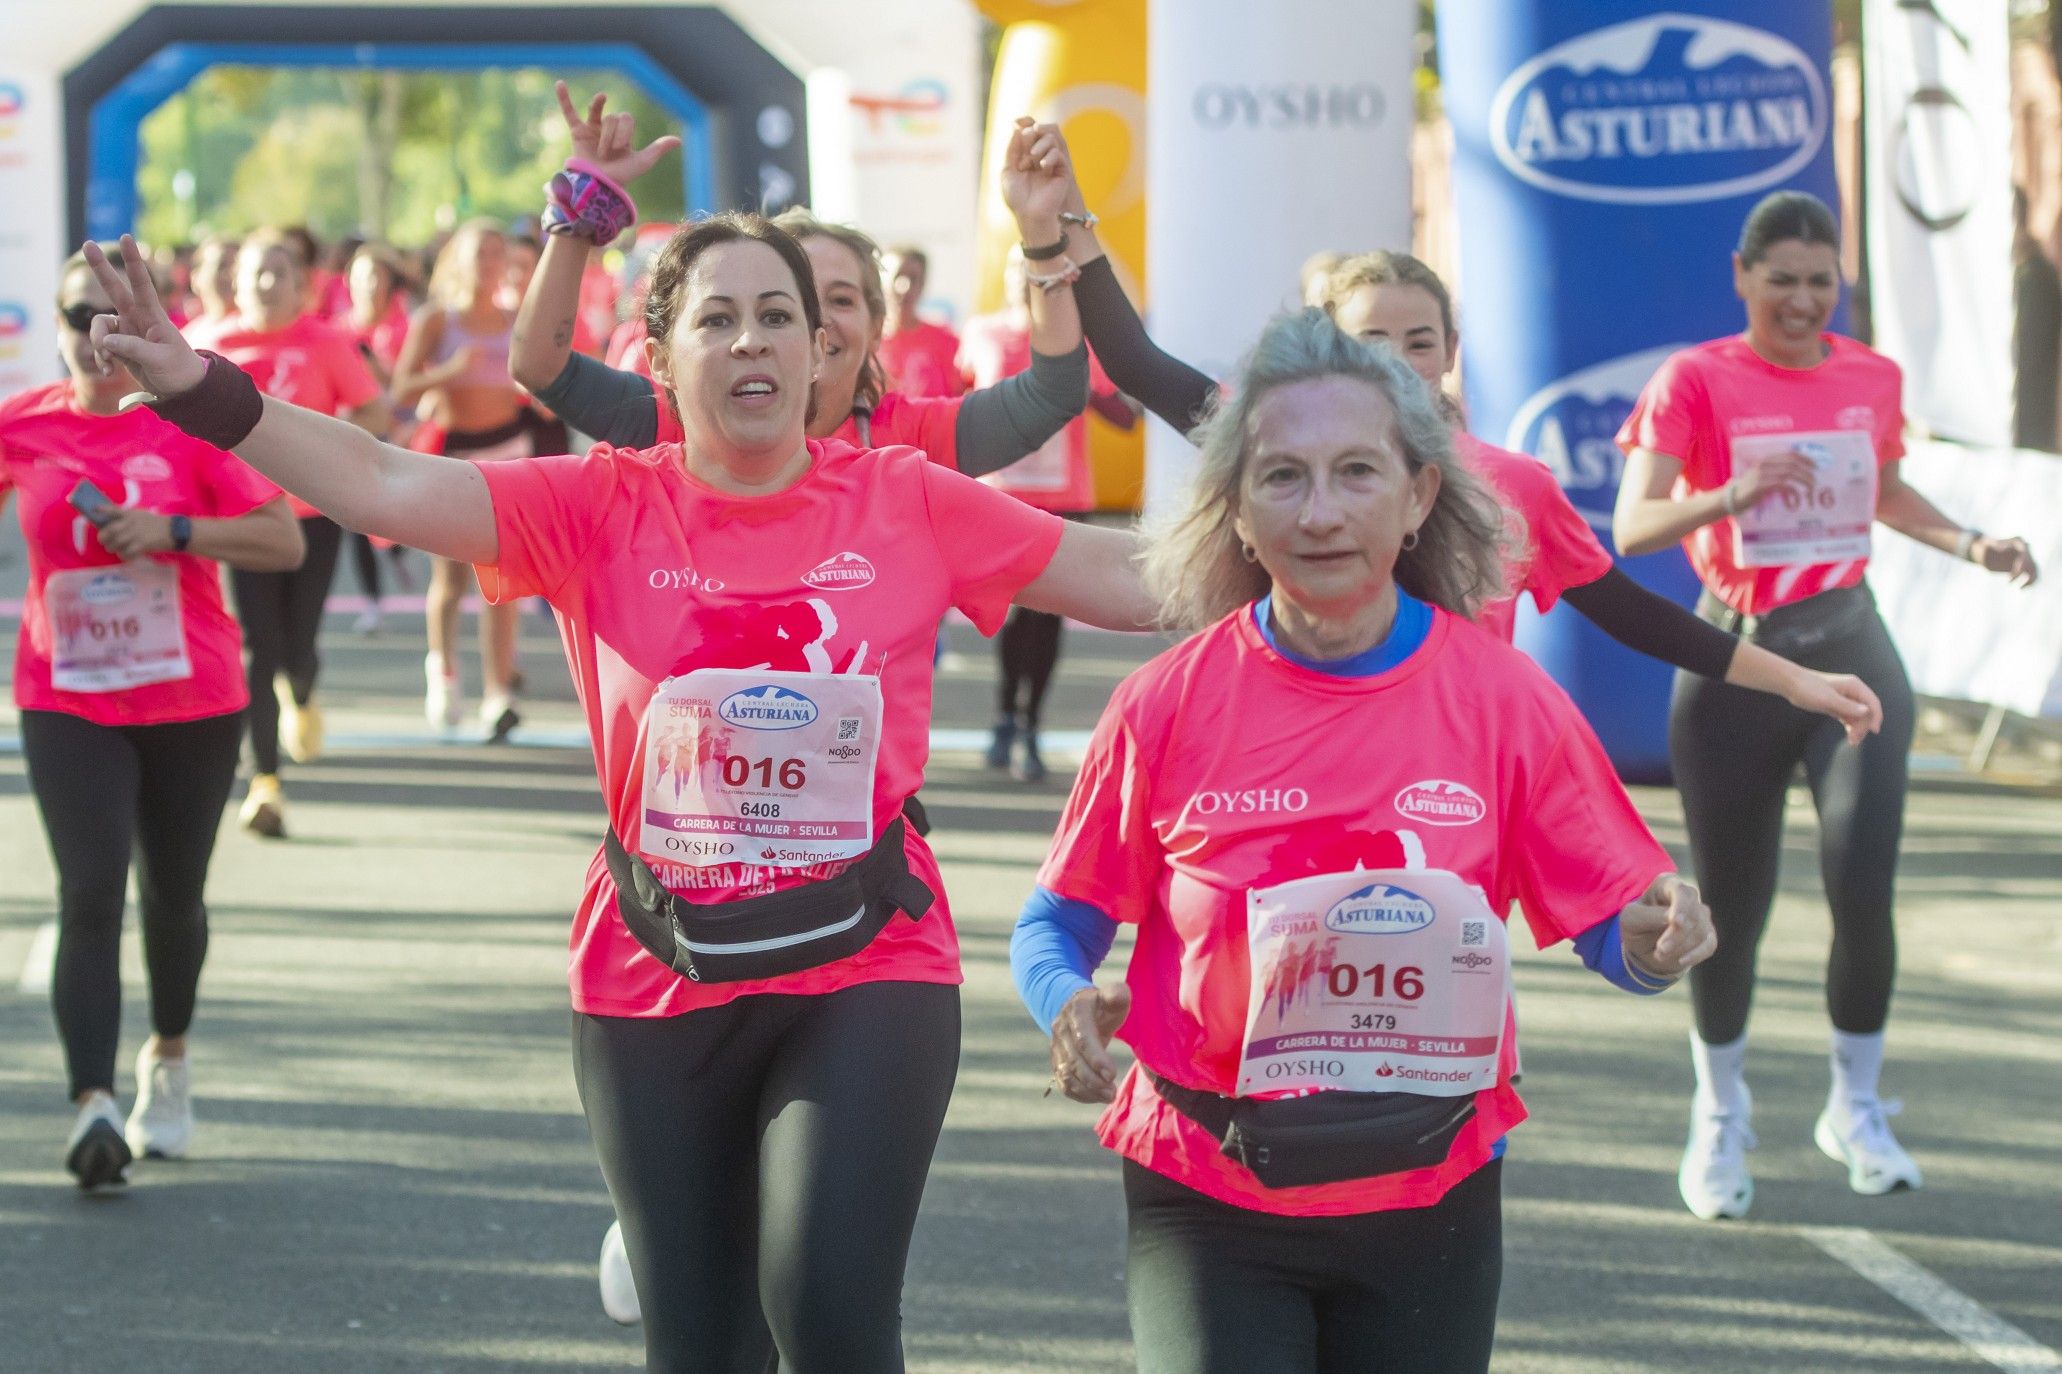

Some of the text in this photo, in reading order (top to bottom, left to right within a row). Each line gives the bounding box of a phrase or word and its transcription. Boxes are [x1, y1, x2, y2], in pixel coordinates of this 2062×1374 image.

[1192, 81, 1386, 132] OYSHO
[1514, 87, 1812, 163] ASTURIANA
[807, 568, 872, 583] ASTURIANA
[668, 697, 713, 707] TU DORSAL
[725, 701, 810, 721] ASTURIANA
[669, 705, 712, 719] SUMA
[722, 754, 806, 790] 016
[740, 802, 780, 818] 6408
[1195, 788, 1309, 815] OYSHO
[1403, 793, 1477, 818] ASTURIANA
[673, 818, 838, 836] CARRERA DE LA MUJER SEVILLA
[665, 837, 734, 856] OYSHO
[778, 849, 845, 862] Santander
[651, 863, 735, 888] CARRERA
[1332, 908, 1425, 927] ASTURIANA
[1270, 920, 1318, 938] SUMA
[1328, 963, 1424, 1000] 016
[1351, 1014, 1396, 1030] 3479
[1276, 1036, 1466, 1053] CARRERA DE LA MUJER SEVILLA
[1265, 1060, 1344, 1079] OYSHO
[1396, 1065, 1472, 1082] Santander
